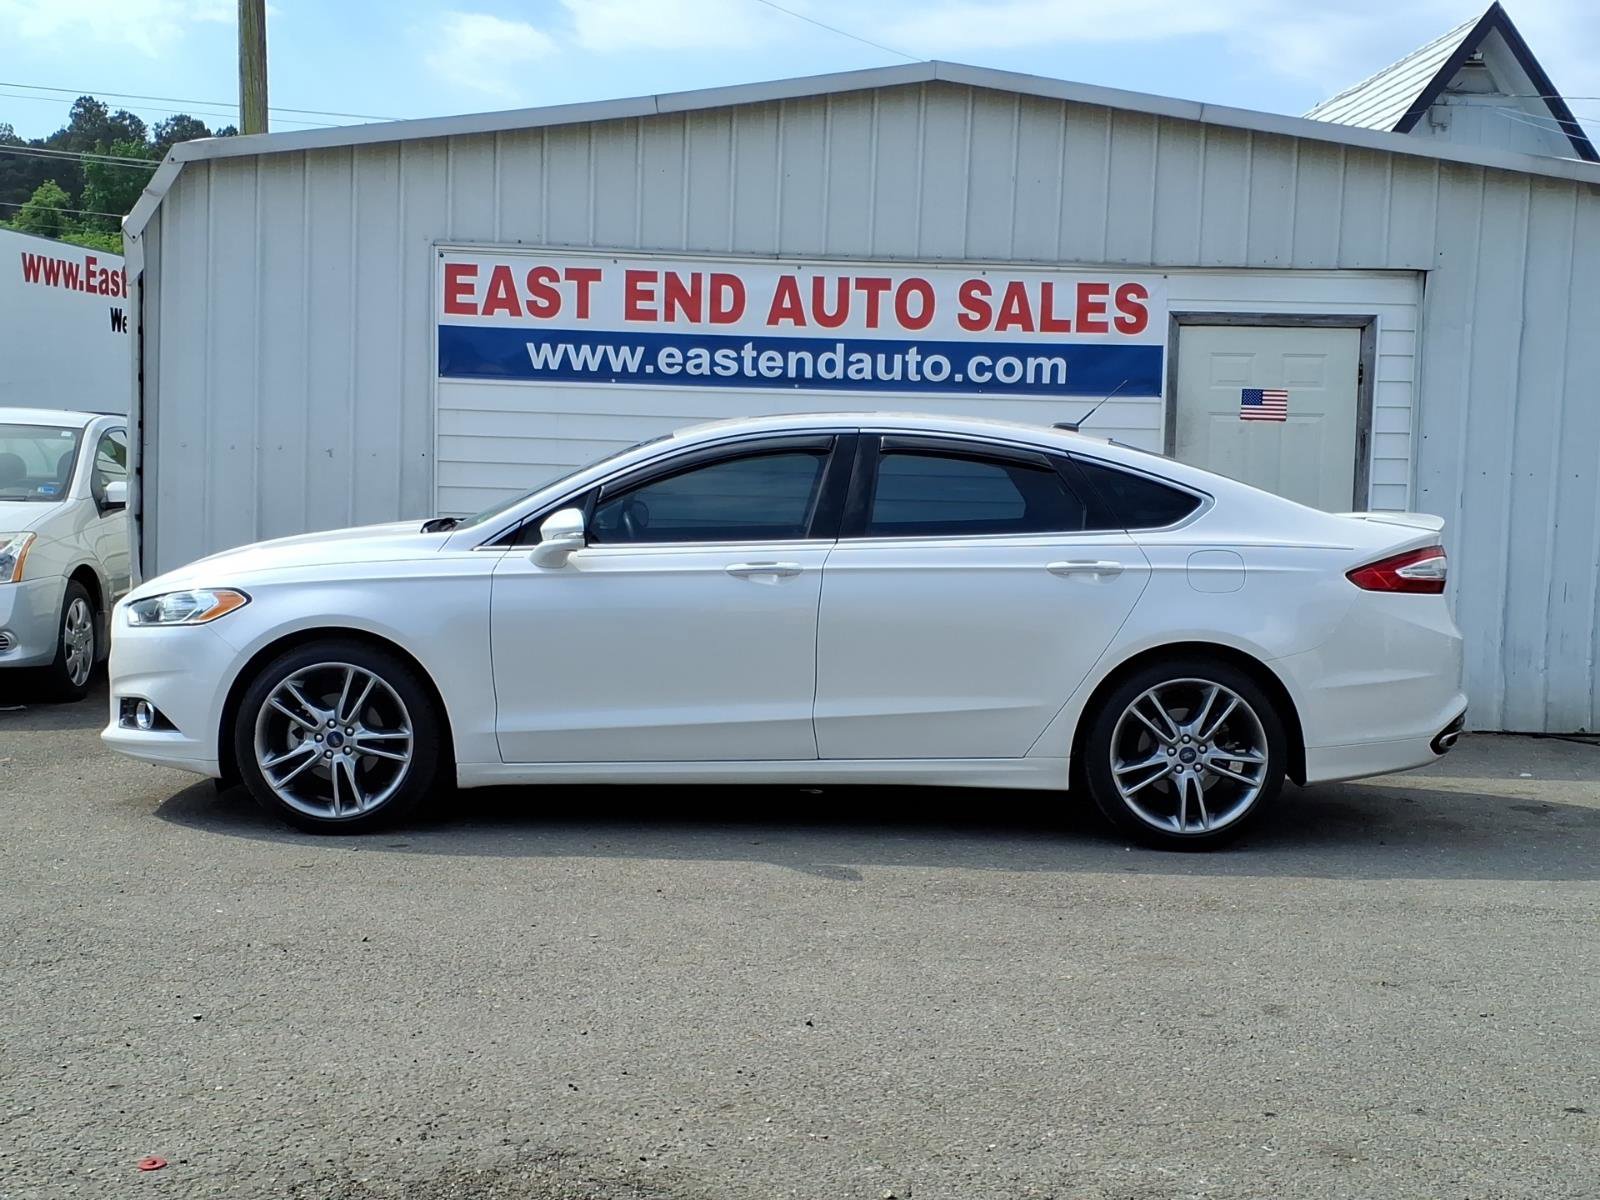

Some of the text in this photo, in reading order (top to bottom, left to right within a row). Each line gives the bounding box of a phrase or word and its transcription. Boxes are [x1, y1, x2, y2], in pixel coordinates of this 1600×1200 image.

[443, 262, 1149, 335] EAST END AUTO SALES
[526, 341, 1067, 385] www.eastendauto.com
